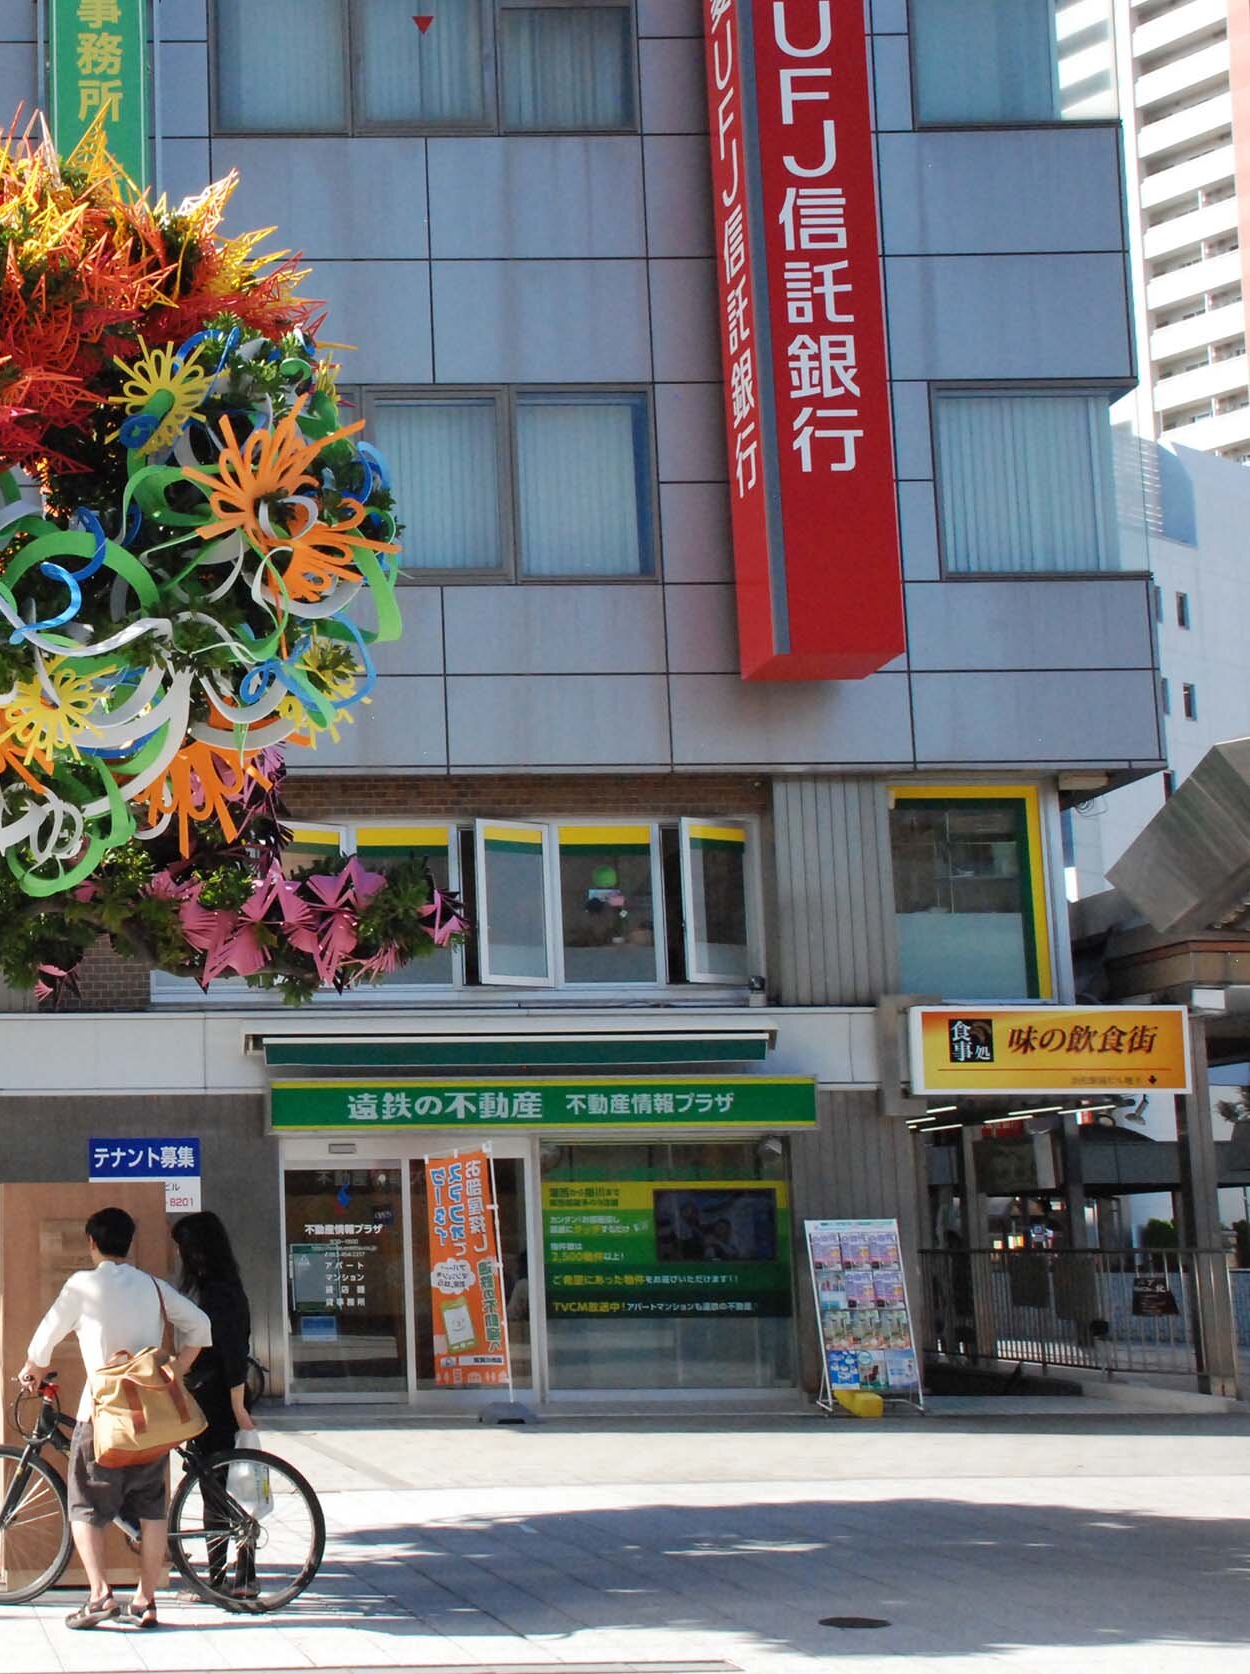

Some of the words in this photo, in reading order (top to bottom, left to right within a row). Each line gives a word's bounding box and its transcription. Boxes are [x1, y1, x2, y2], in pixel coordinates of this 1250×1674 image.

[773, 1, 863, 472] UFJ信託銀行
[1007, 1025, 1158, 1054] 味の飲食街
[348, 1092, 542, 1120] 遠鉄の不動産
[566, 1093, 734, 1115] 不動産情報プラザ
[94, 1145, 195, 1168] テナント募集
